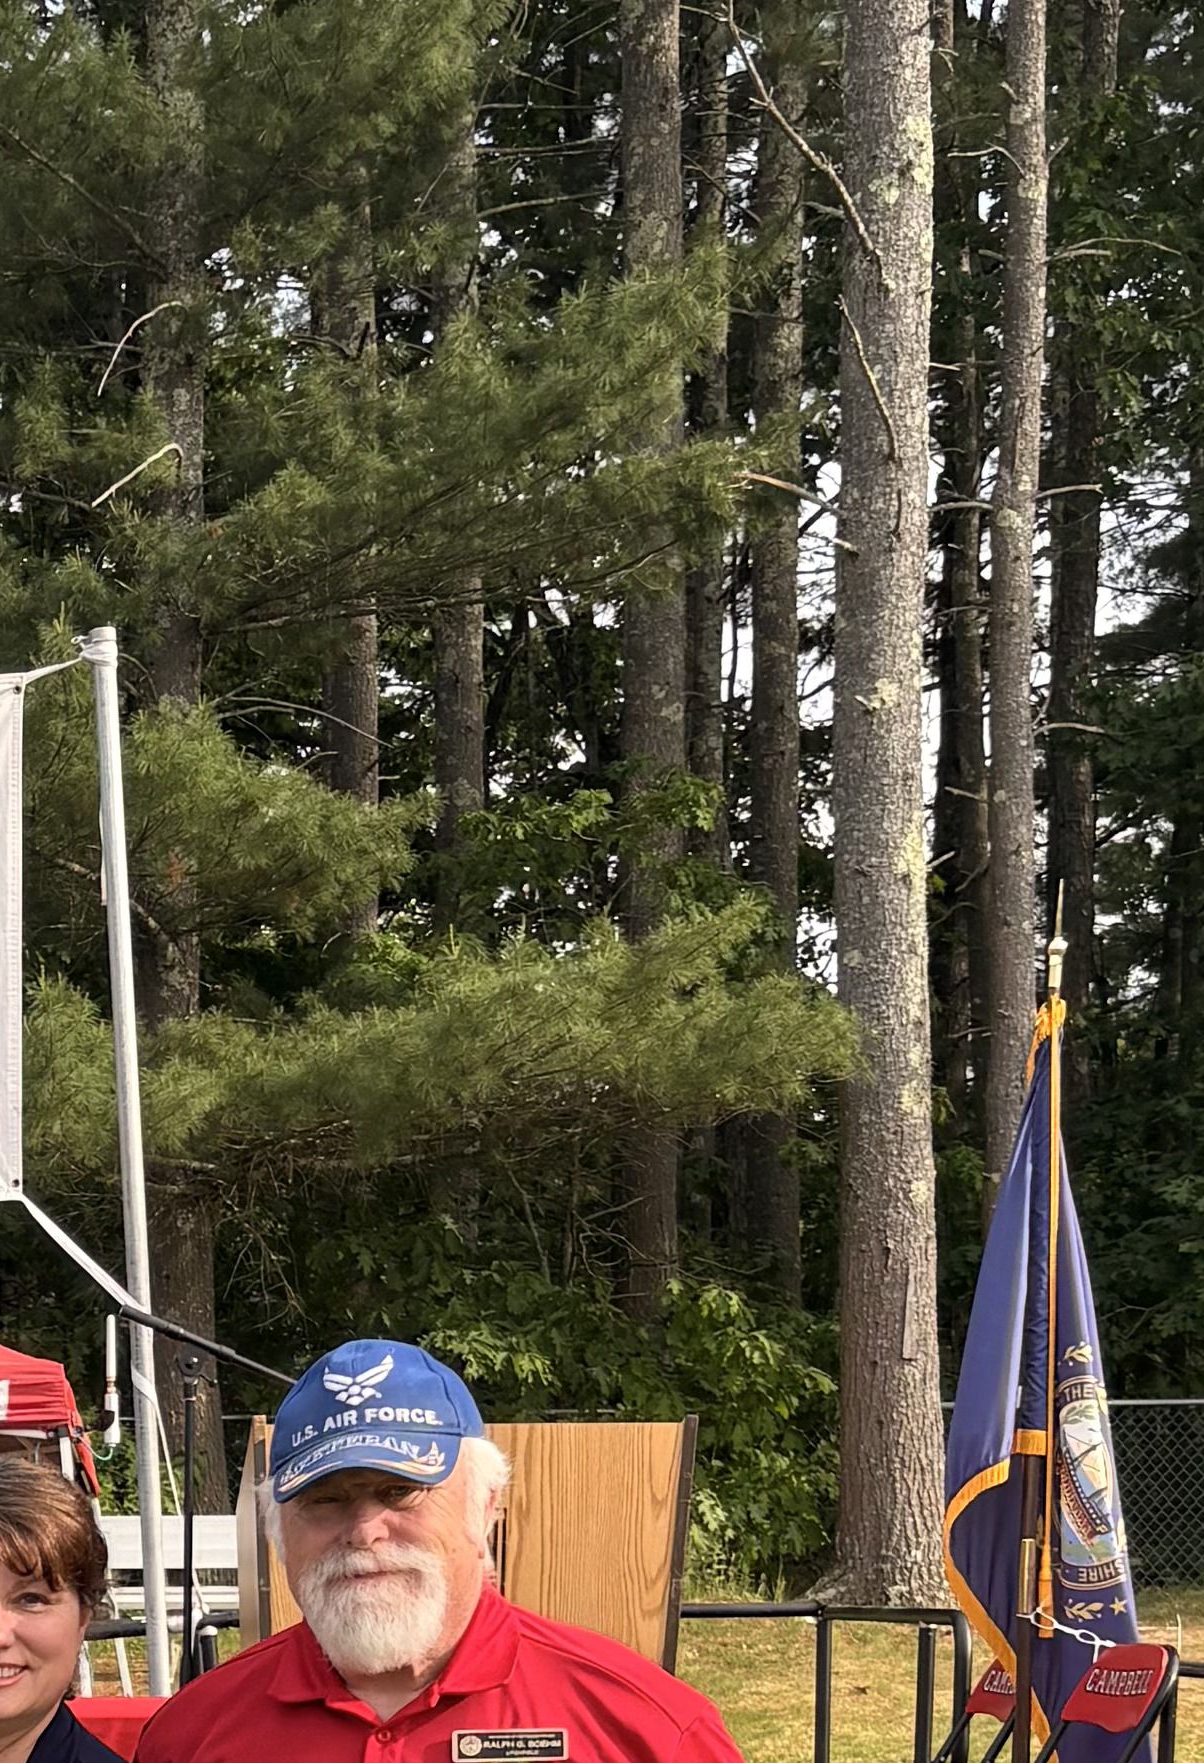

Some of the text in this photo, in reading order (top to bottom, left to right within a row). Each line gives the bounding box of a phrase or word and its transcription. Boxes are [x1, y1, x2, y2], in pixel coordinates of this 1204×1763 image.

[1063, 1383, 1094, 1402] THE
[291, 1424, 319, 1447] U.S.
[323, 1409, 358, 1433] AIR
[1085, 1668, 1154, 1696] CAMPBELL
